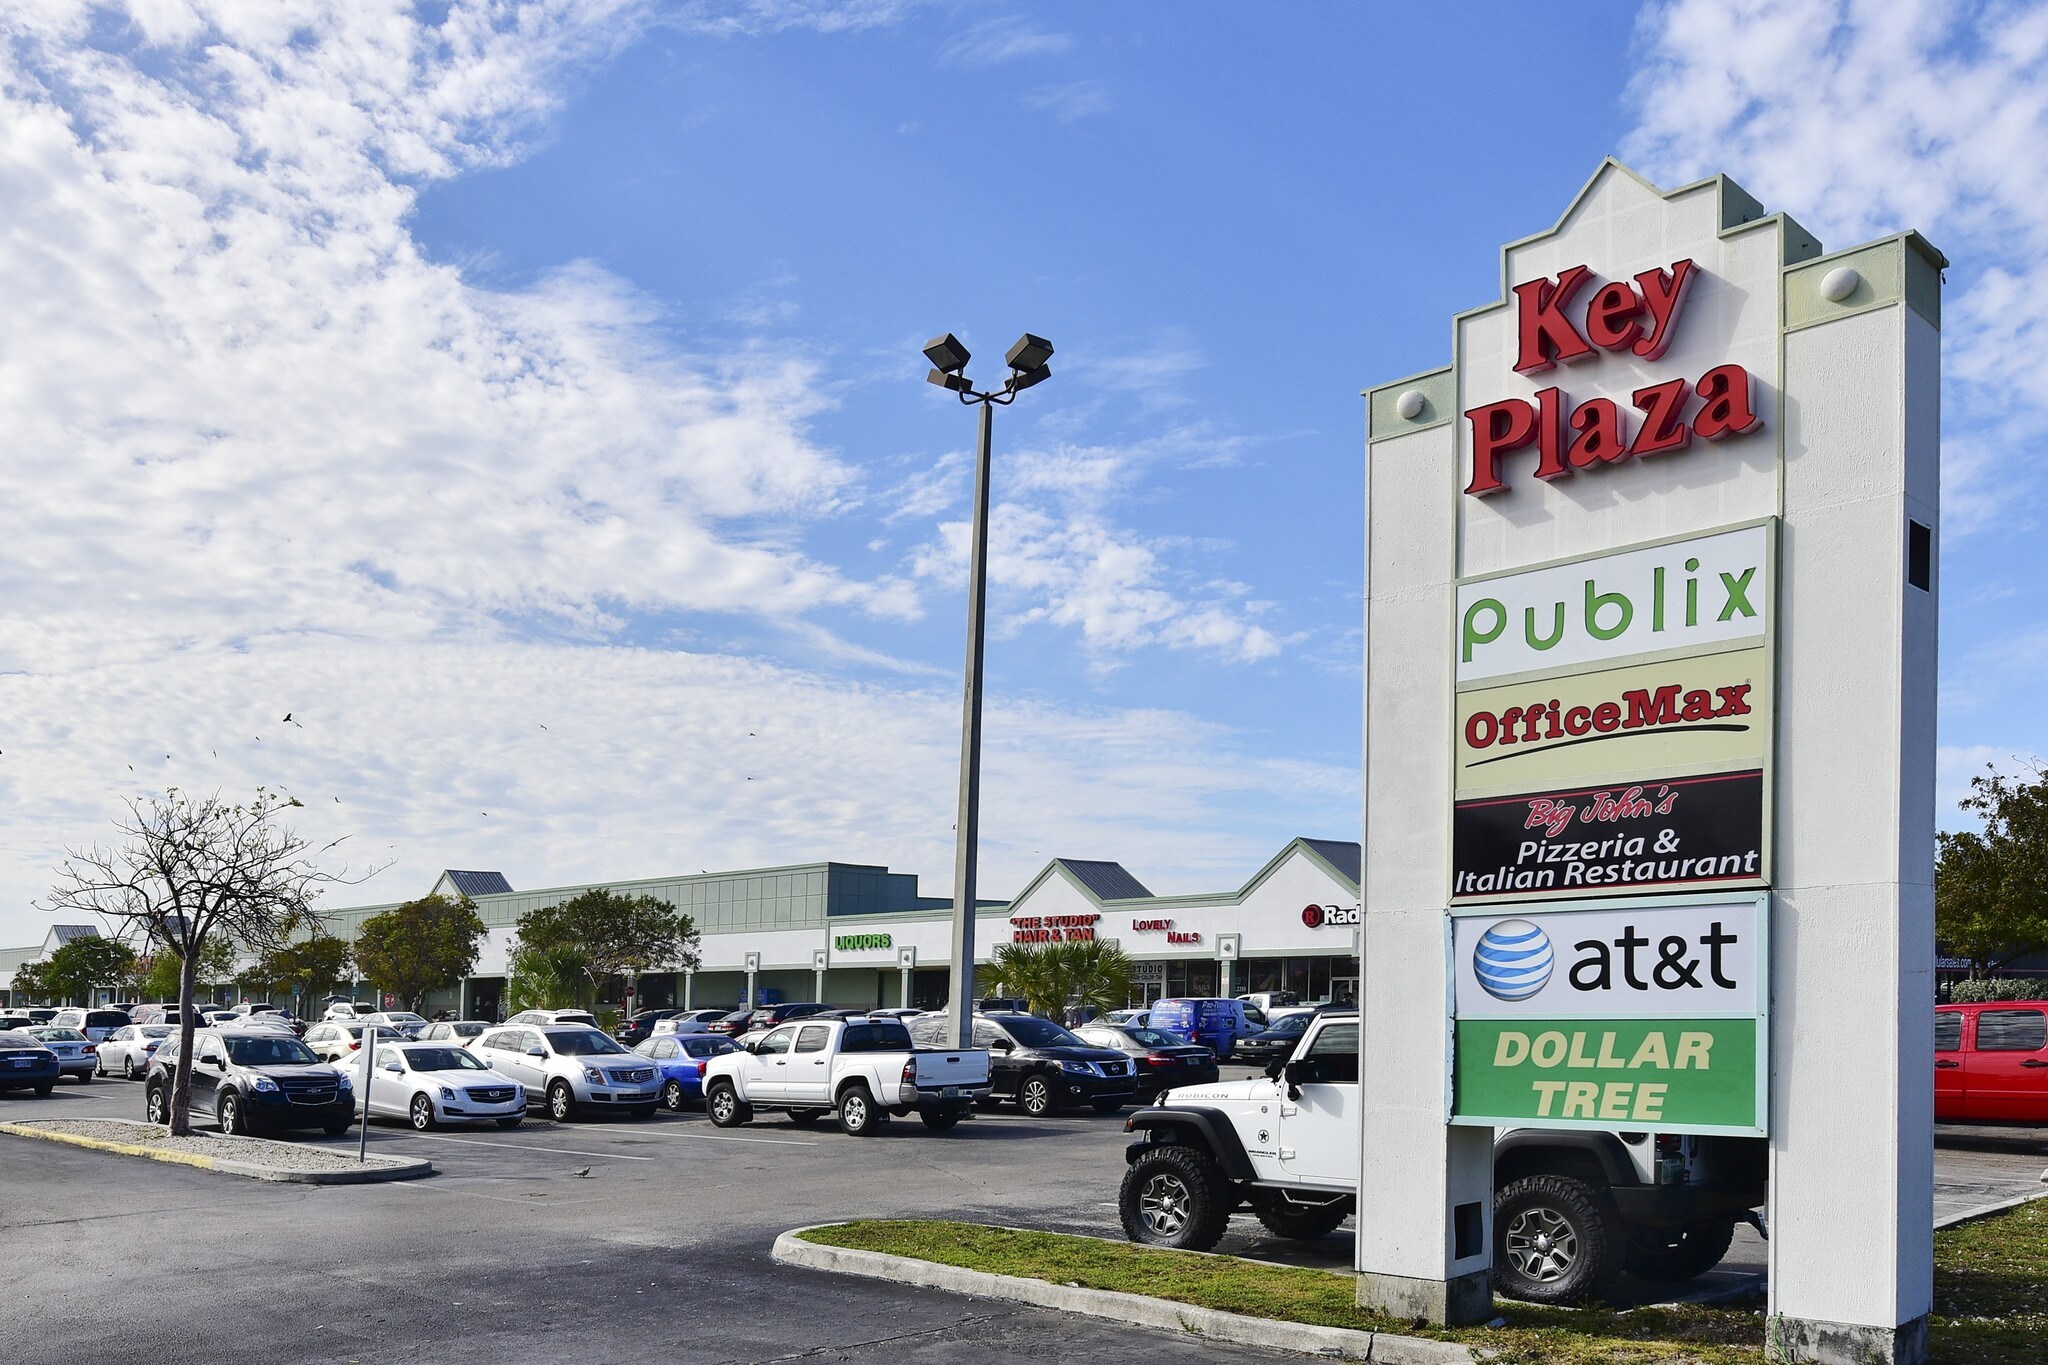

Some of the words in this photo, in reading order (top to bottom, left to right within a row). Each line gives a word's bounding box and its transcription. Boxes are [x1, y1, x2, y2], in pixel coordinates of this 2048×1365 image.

[1513, 258, 1701, 375] Key
[1464, 363, 1765, 497] Plaza
[1465, 683, 1751, 748] OfficeMax
[1524, 799, 1576, 838] Big
[1580, 784, 1678, 823] John's
[1517, 833, 1645, 865] Pizzeria
[1653, 828, 1681, 853] &
[1455, 862, 1554, 893] Italian
[1563, 850, 1759, 886] Restaurant
[835, 933, 891, 949] LIQUORS
[1013, 930, 1049, 943] HAIR
[1050, 929, 1062, 942] &
[1063, 928, 1094, 941] TAN
[1133, 919, 1172, 930] LOVELY
[1167, 931, 1200, 943] NAILS
[1568, 921, 1738, 991] at&t
[1493, 1030, 1714, 1069] DOLLAR
[1532, 1080, 1668, 1120] TREE
